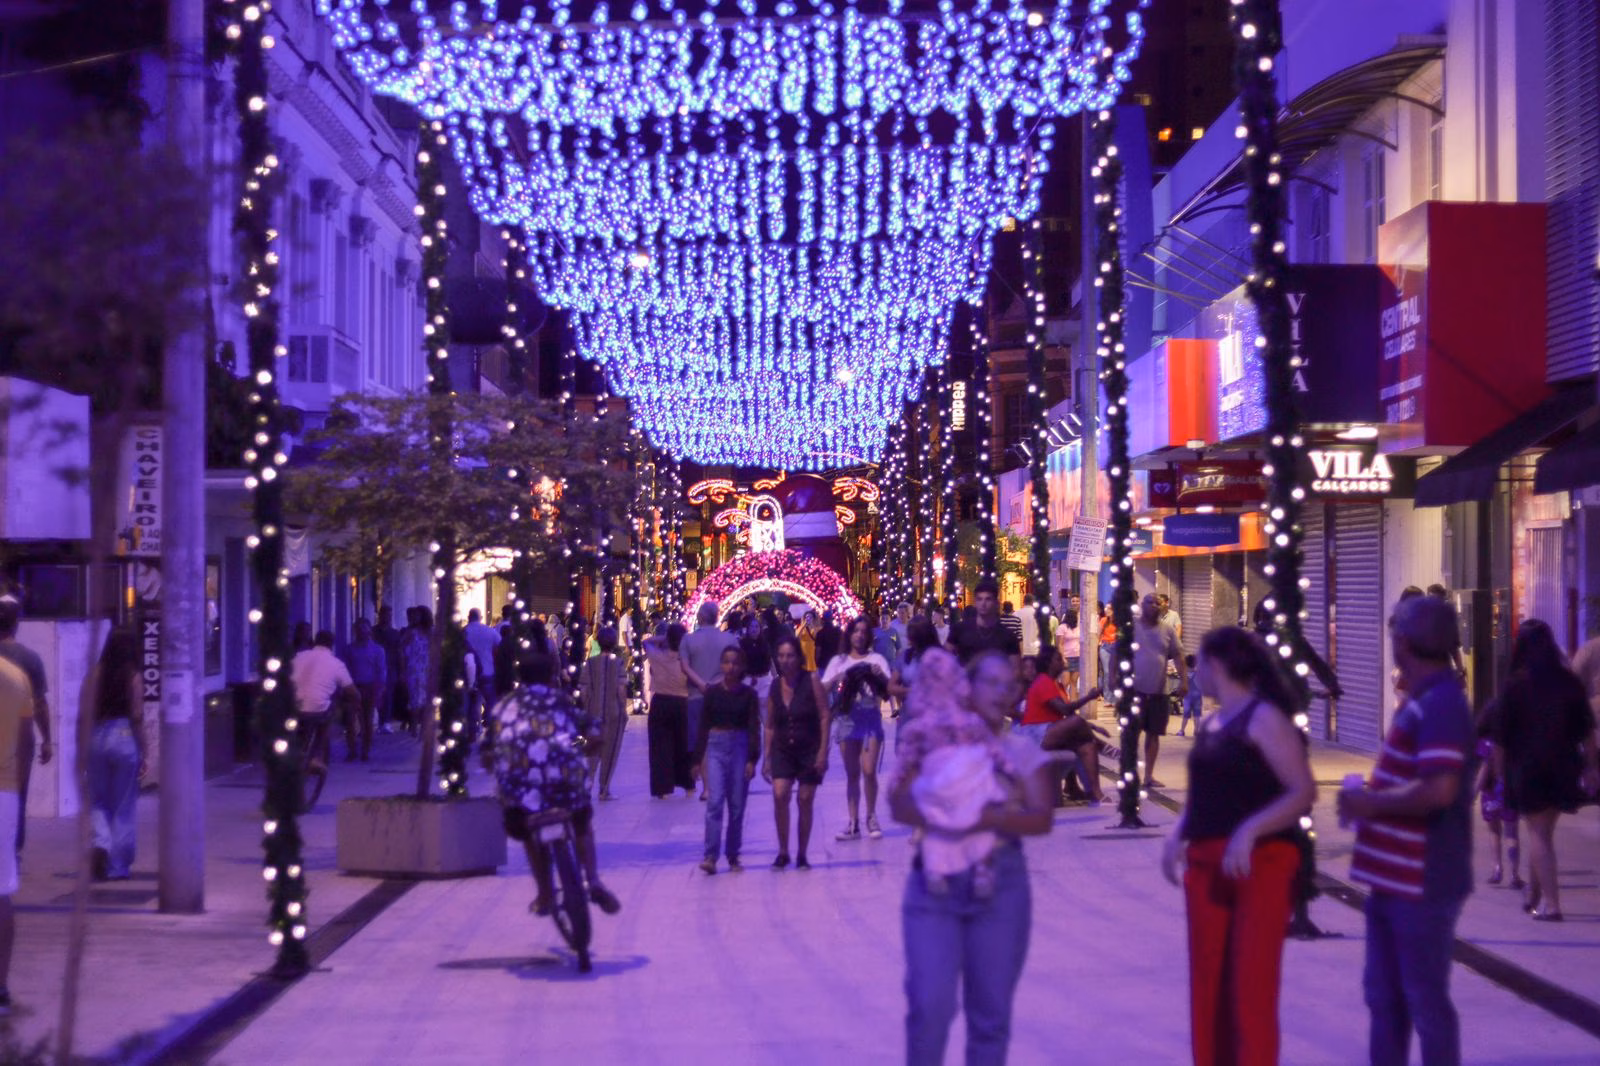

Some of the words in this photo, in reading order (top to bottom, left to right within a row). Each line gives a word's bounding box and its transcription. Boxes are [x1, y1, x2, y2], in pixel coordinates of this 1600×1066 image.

[1382, 296, 1420, 339] CENTRAL
[135, 429, 159, 526] CHAVEIRO
[1308, 451, 1393, 478] VILA
[1312, 480, 1391, 493] CALÇADOS
[144, 621, 159, 698] XEROX
